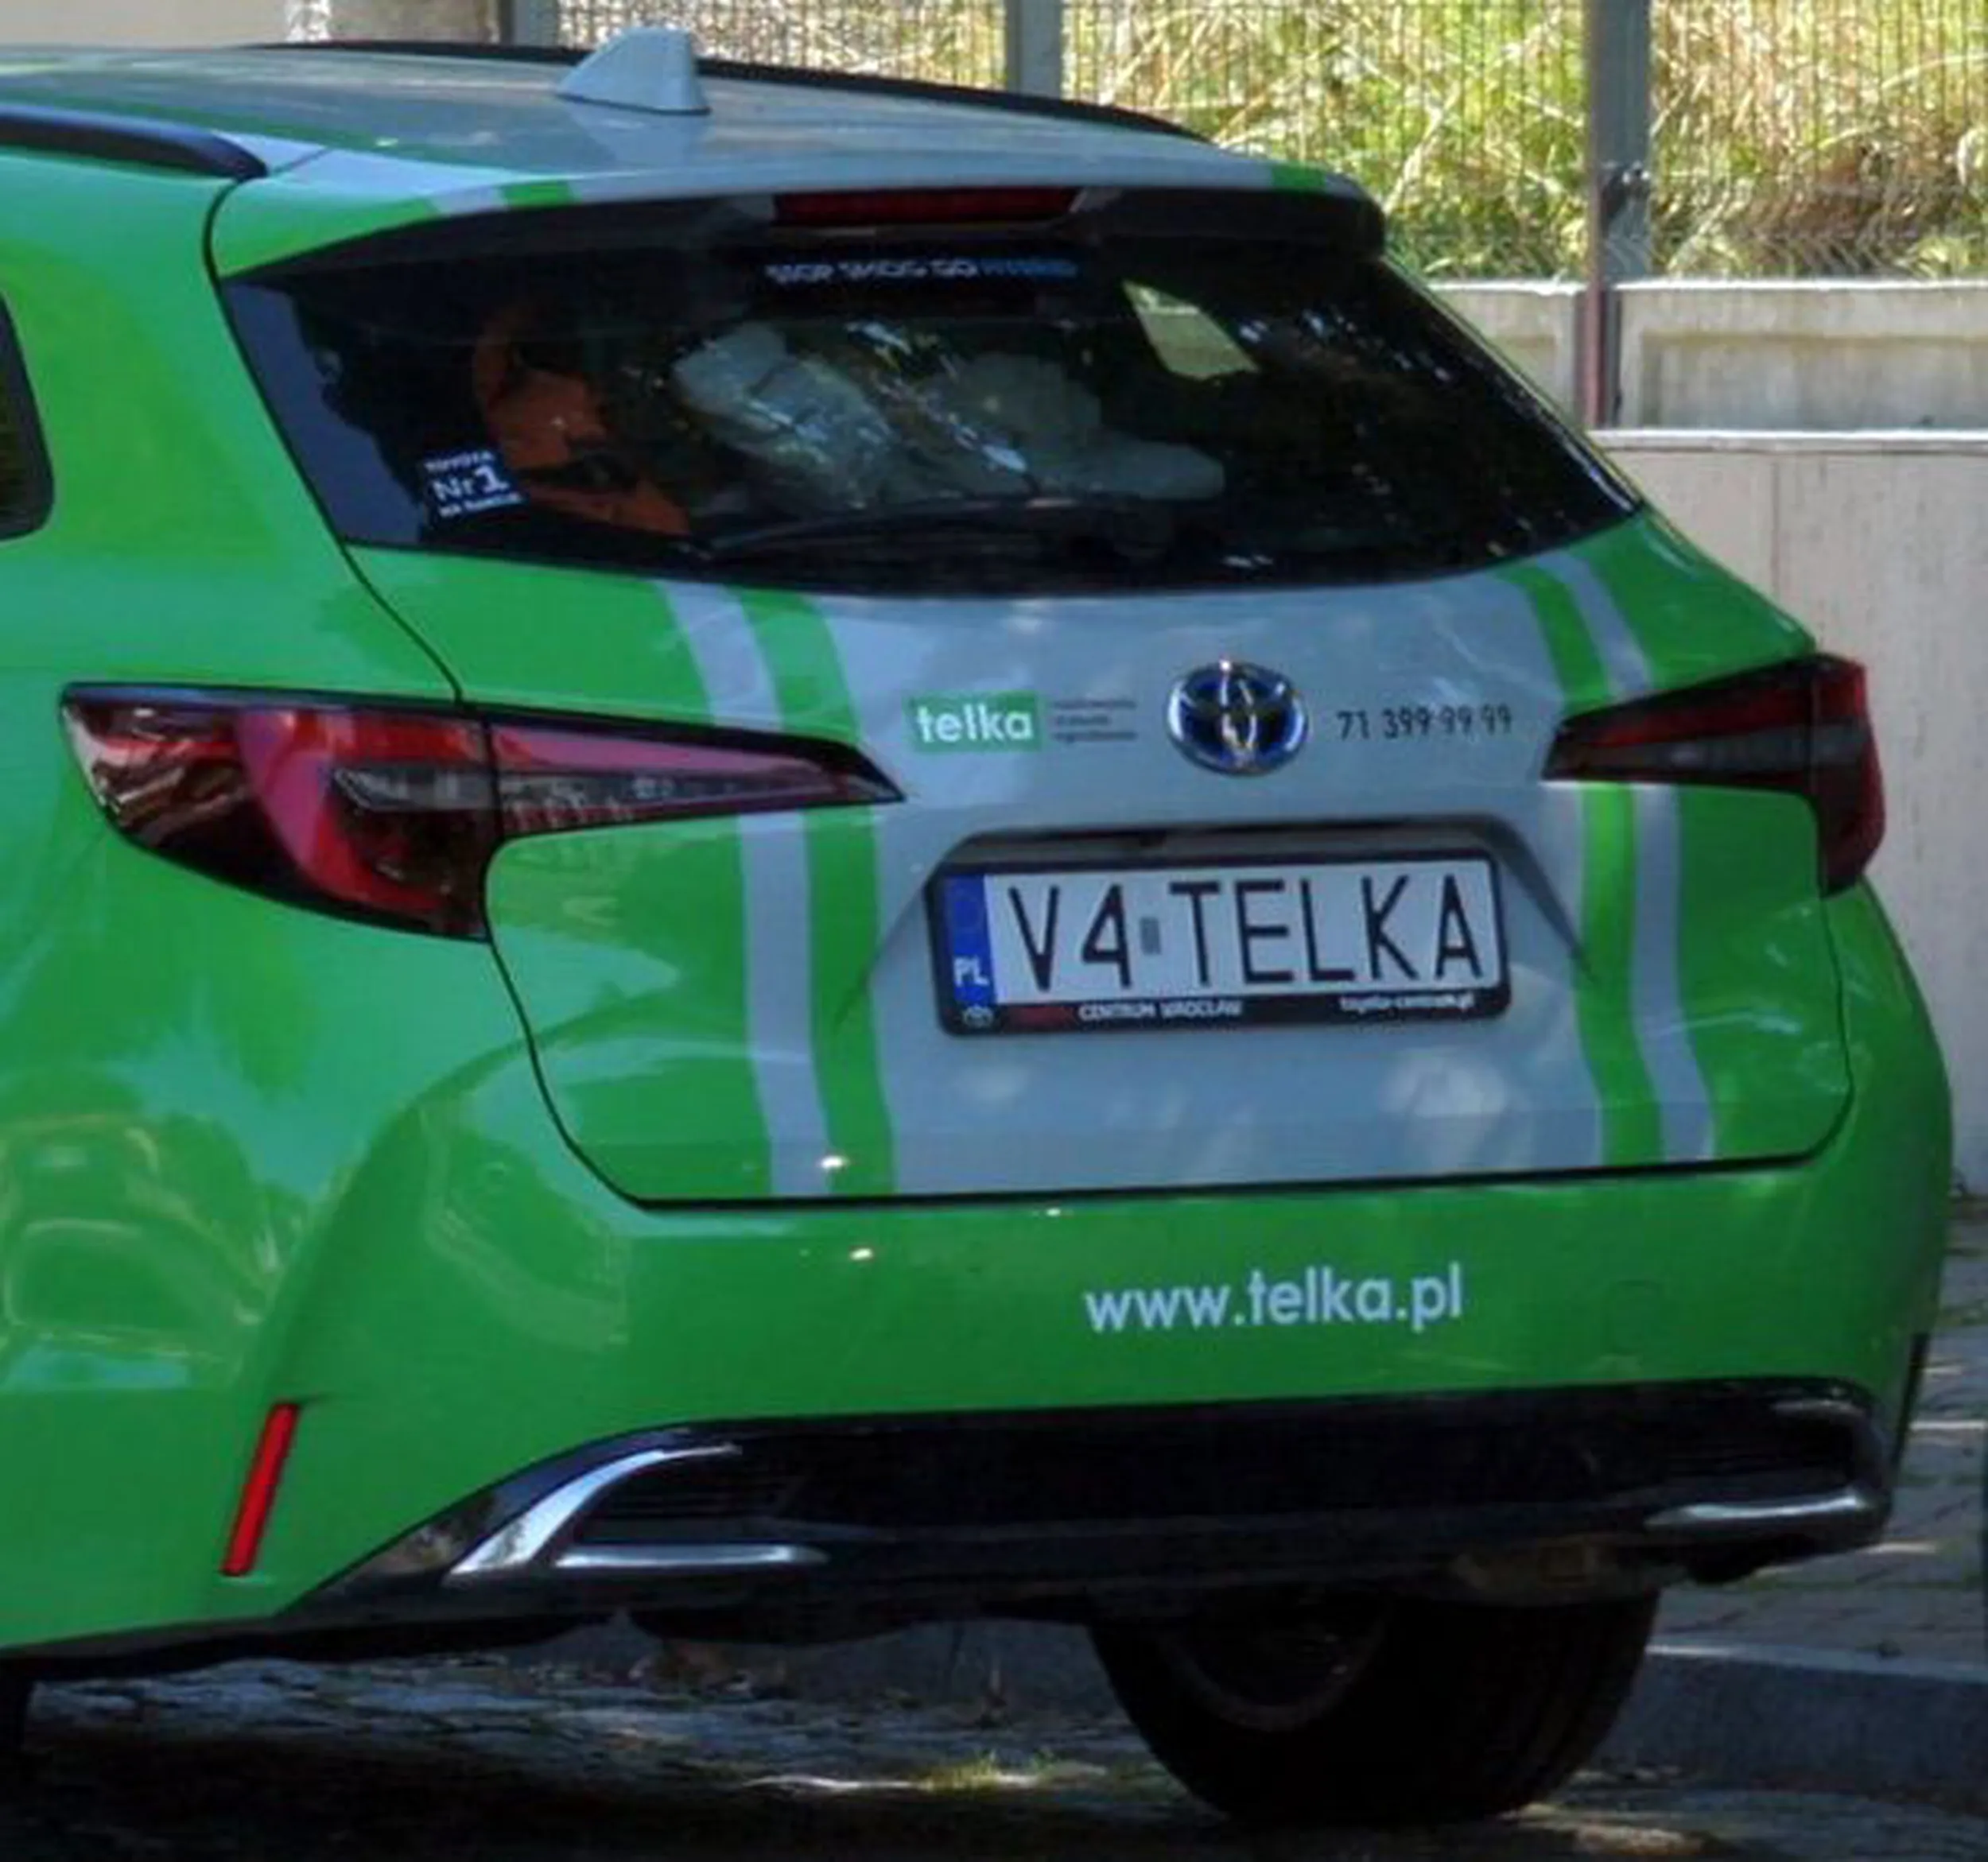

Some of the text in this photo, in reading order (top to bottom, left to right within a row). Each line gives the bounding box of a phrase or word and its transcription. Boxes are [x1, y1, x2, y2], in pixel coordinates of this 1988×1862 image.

[433, 465, 509, 501] Nr 1
[917, 703, 1034, 743] telka
[1335, 703, 1512, 740] 71 399 99 99
[1008, 875, 1482, 992] V4 TELKA
[955, 956, 990, 987] PL
[1085, 1262, 1463, 1333] www.telka.pl
